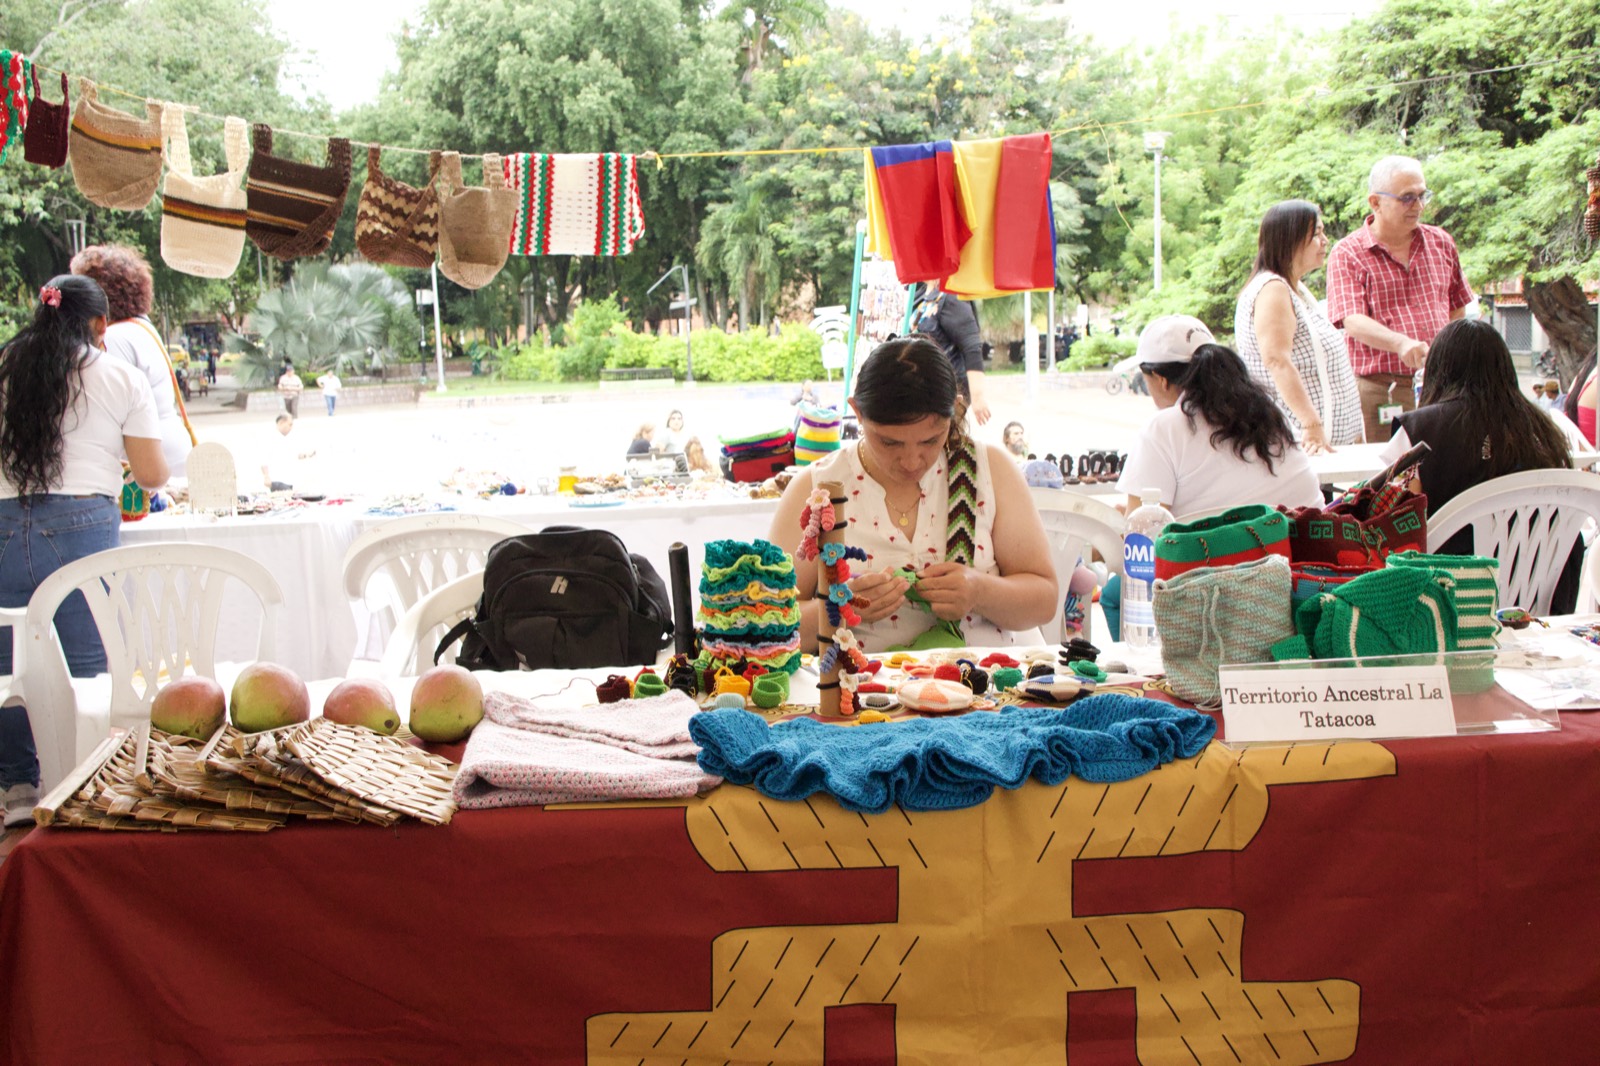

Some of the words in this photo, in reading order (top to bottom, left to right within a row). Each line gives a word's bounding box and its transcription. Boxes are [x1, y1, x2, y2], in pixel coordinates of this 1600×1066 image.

[1225, 686, 1317, 705] Territorio
[1324, 684, 1413, 702] Ancestral
[1418, 683, 1443, 700] La
[1300, 711, 1376, 728] Tatacoa
